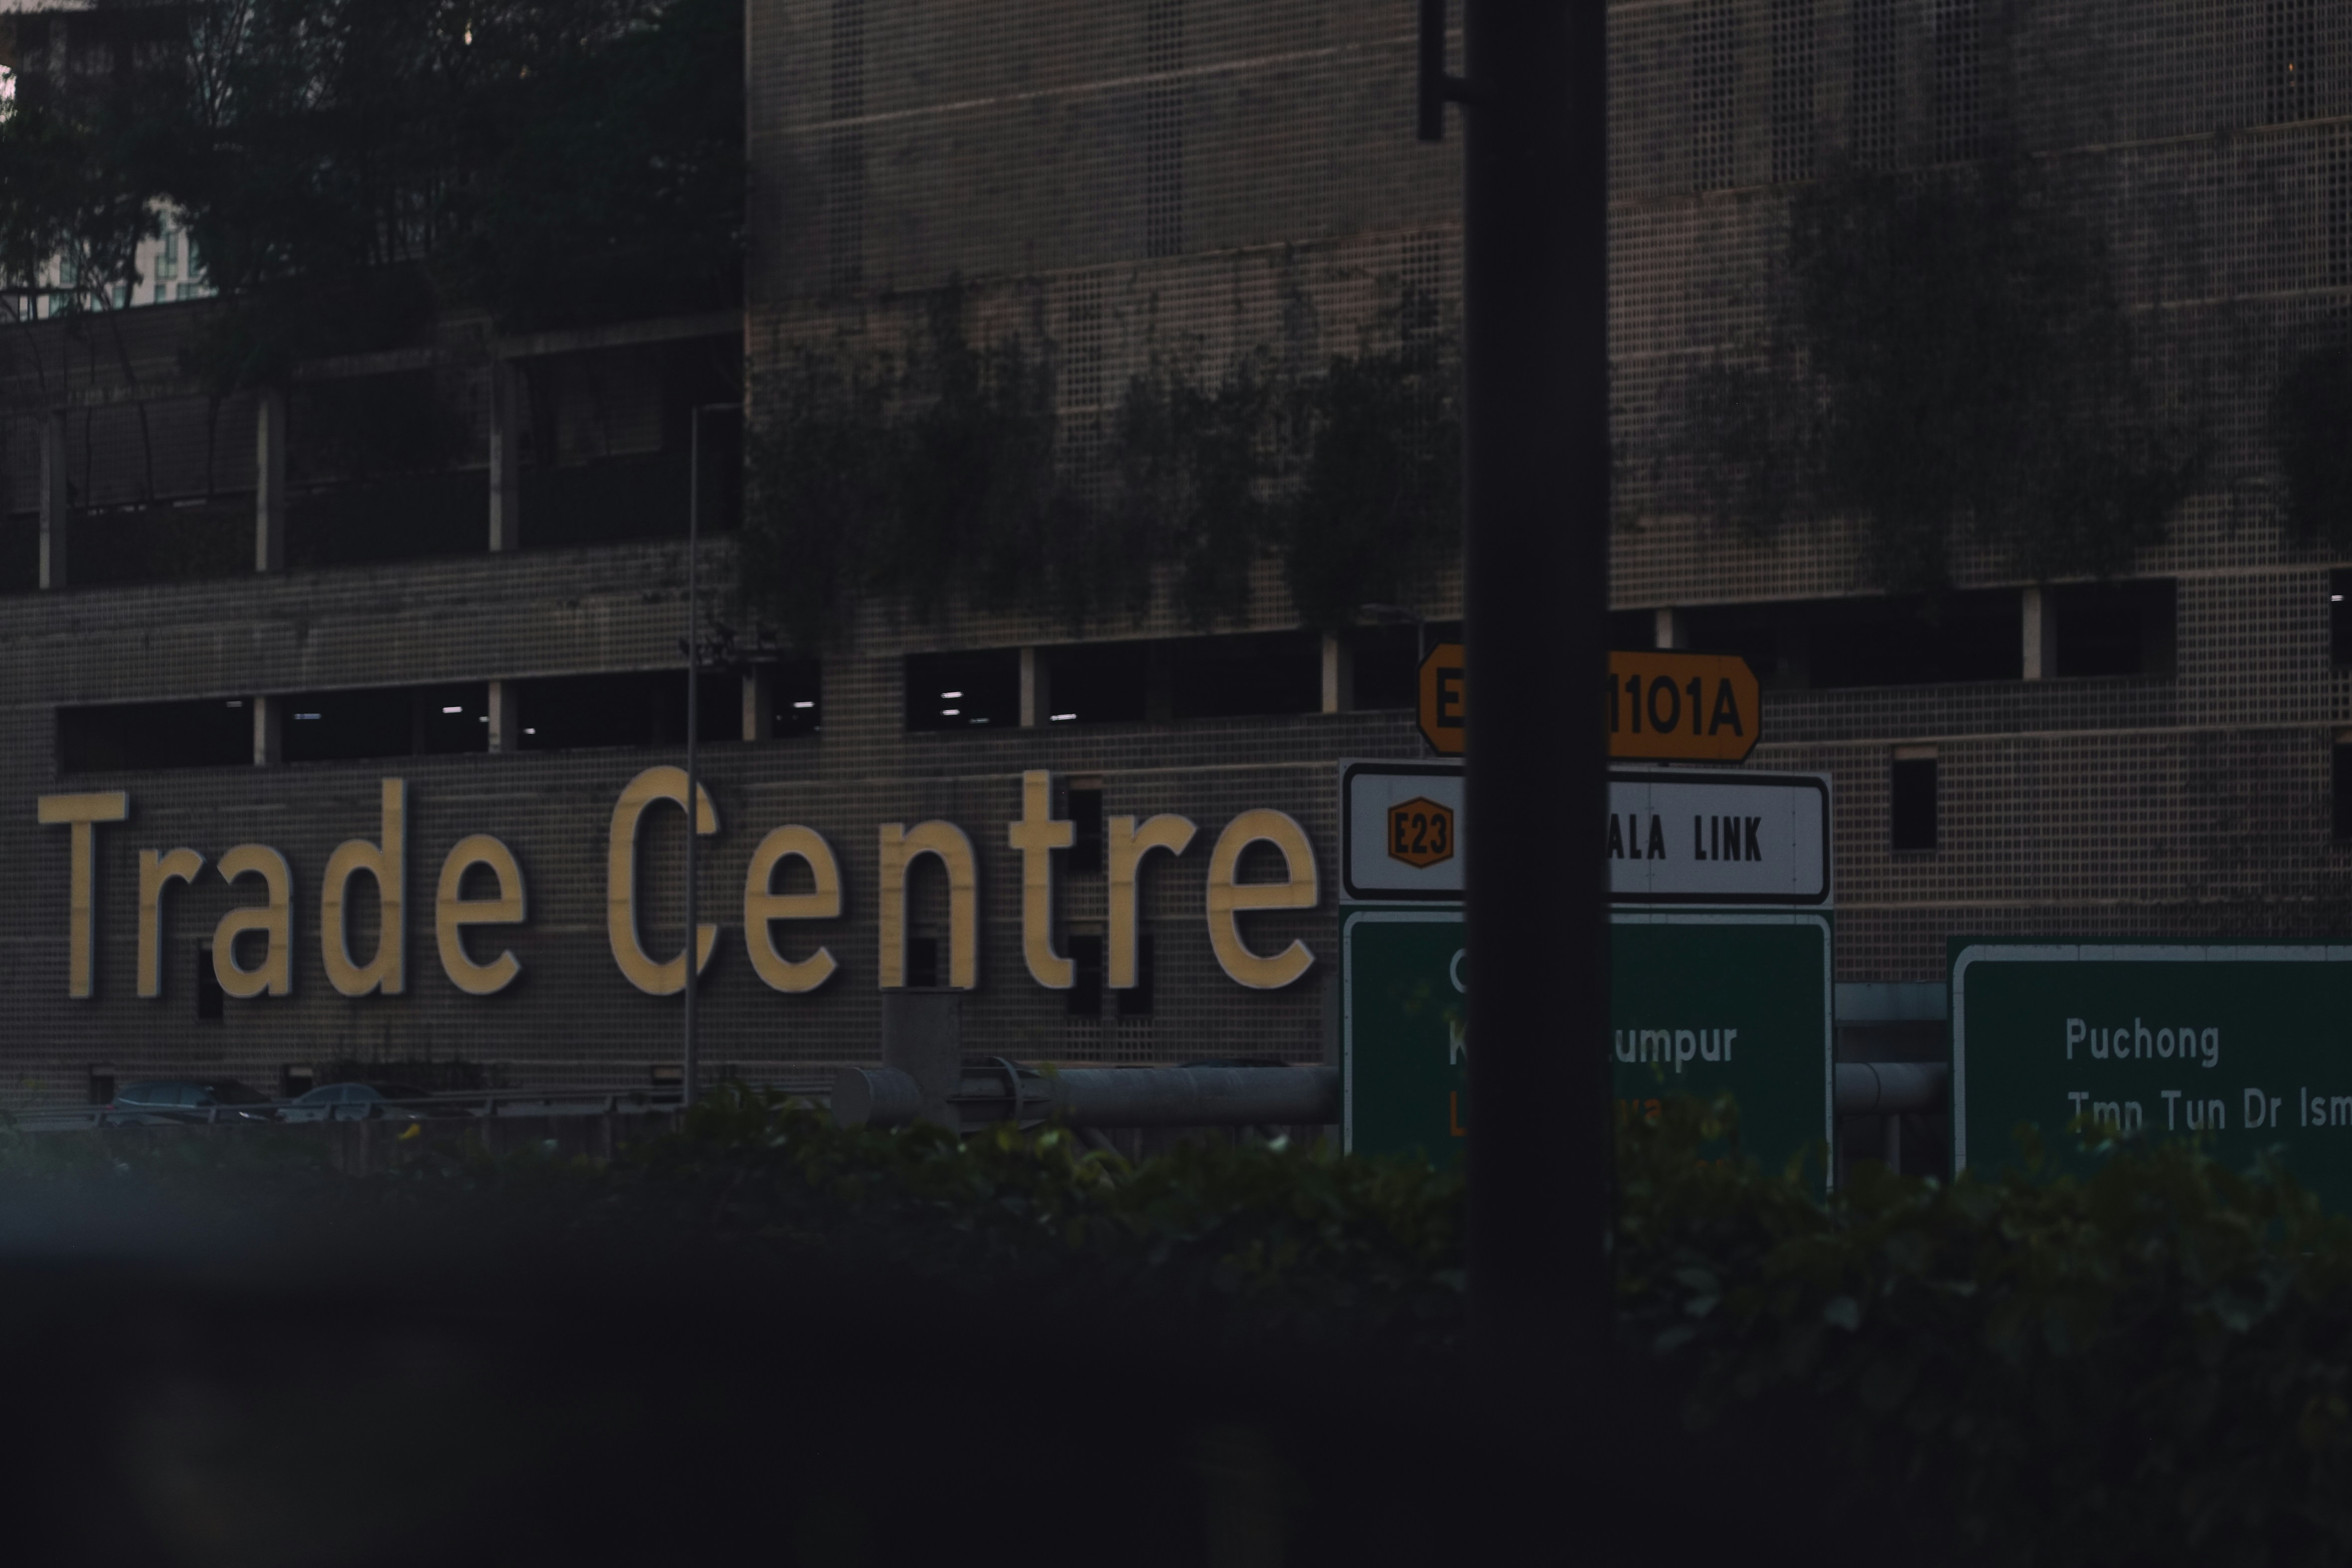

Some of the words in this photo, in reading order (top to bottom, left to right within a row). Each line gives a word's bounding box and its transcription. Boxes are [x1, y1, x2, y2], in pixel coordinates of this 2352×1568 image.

[1604, 673, 1744, 737] 1101A
[1395, 812, 1446, 854] E23
[1606, 813, 1666, 860] ALA
[1695, 815, 1762, 862] LINK
[37, 777, 526, 998] Trade
[607, 764, 1320, 996] Centre
[1608, 1028, 1738, 1073] umpur
[2066, 1017, 2219, 1068] Puchong
[2067, 1091, 2143, 1133] Tmn
[2161, 1089, 2226, 1131] Tun
[2244, 1087, 2282, 1129] Dr
